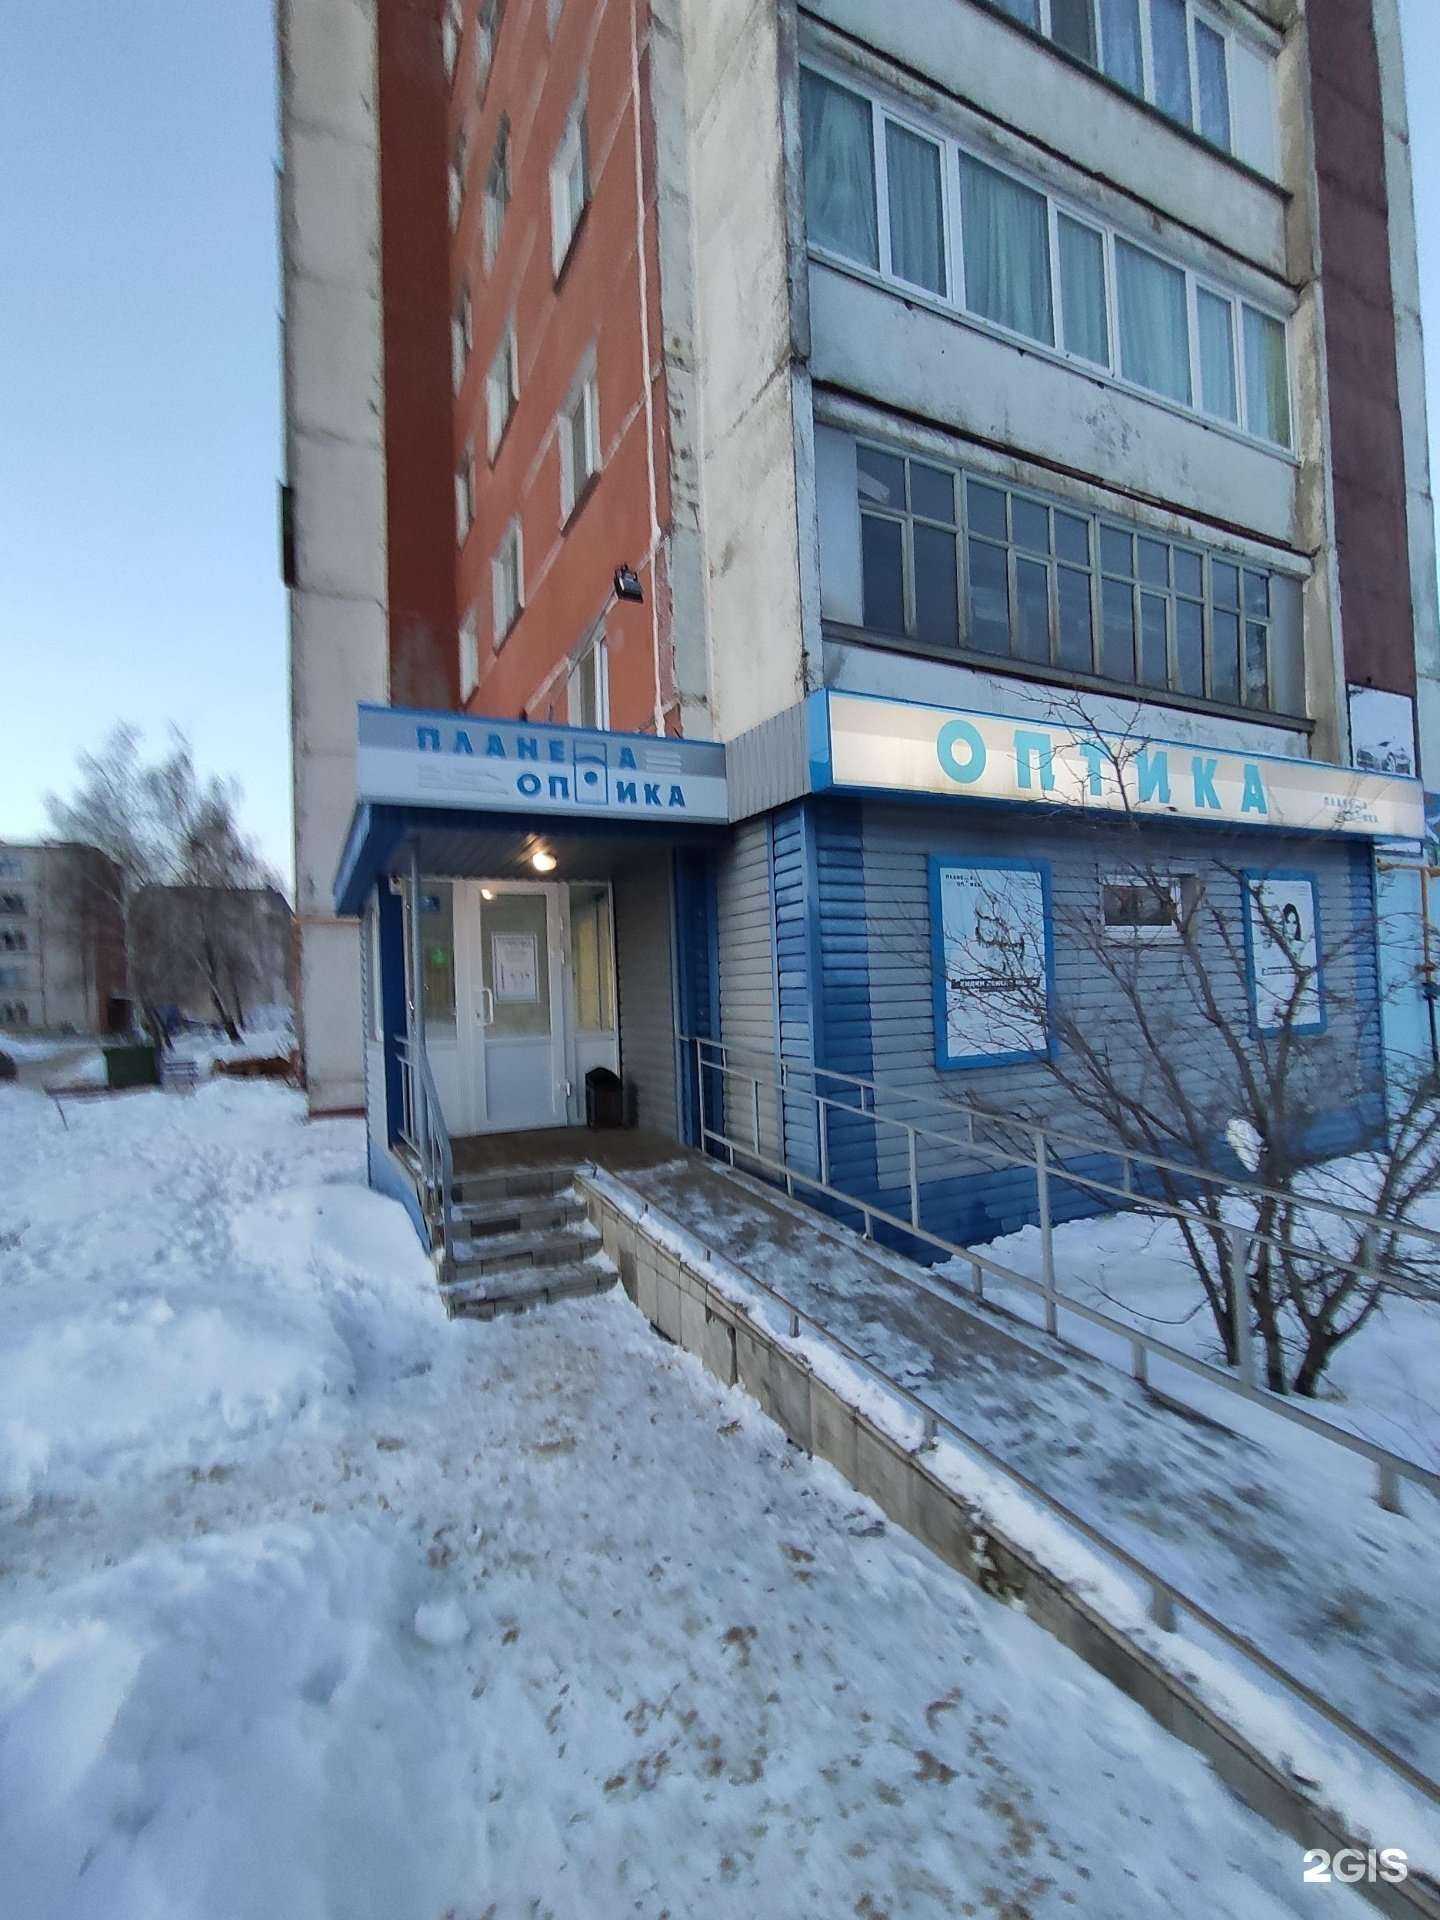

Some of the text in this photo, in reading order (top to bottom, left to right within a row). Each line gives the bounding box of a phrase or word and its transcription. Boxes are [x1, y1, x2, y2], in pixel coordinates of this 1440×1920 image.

[416, 726, 637, 770] ПЛАНЕА
[936, 719, 1268, 815] ОПТИКА
[516, 772, 686, 808] ОПИКА
